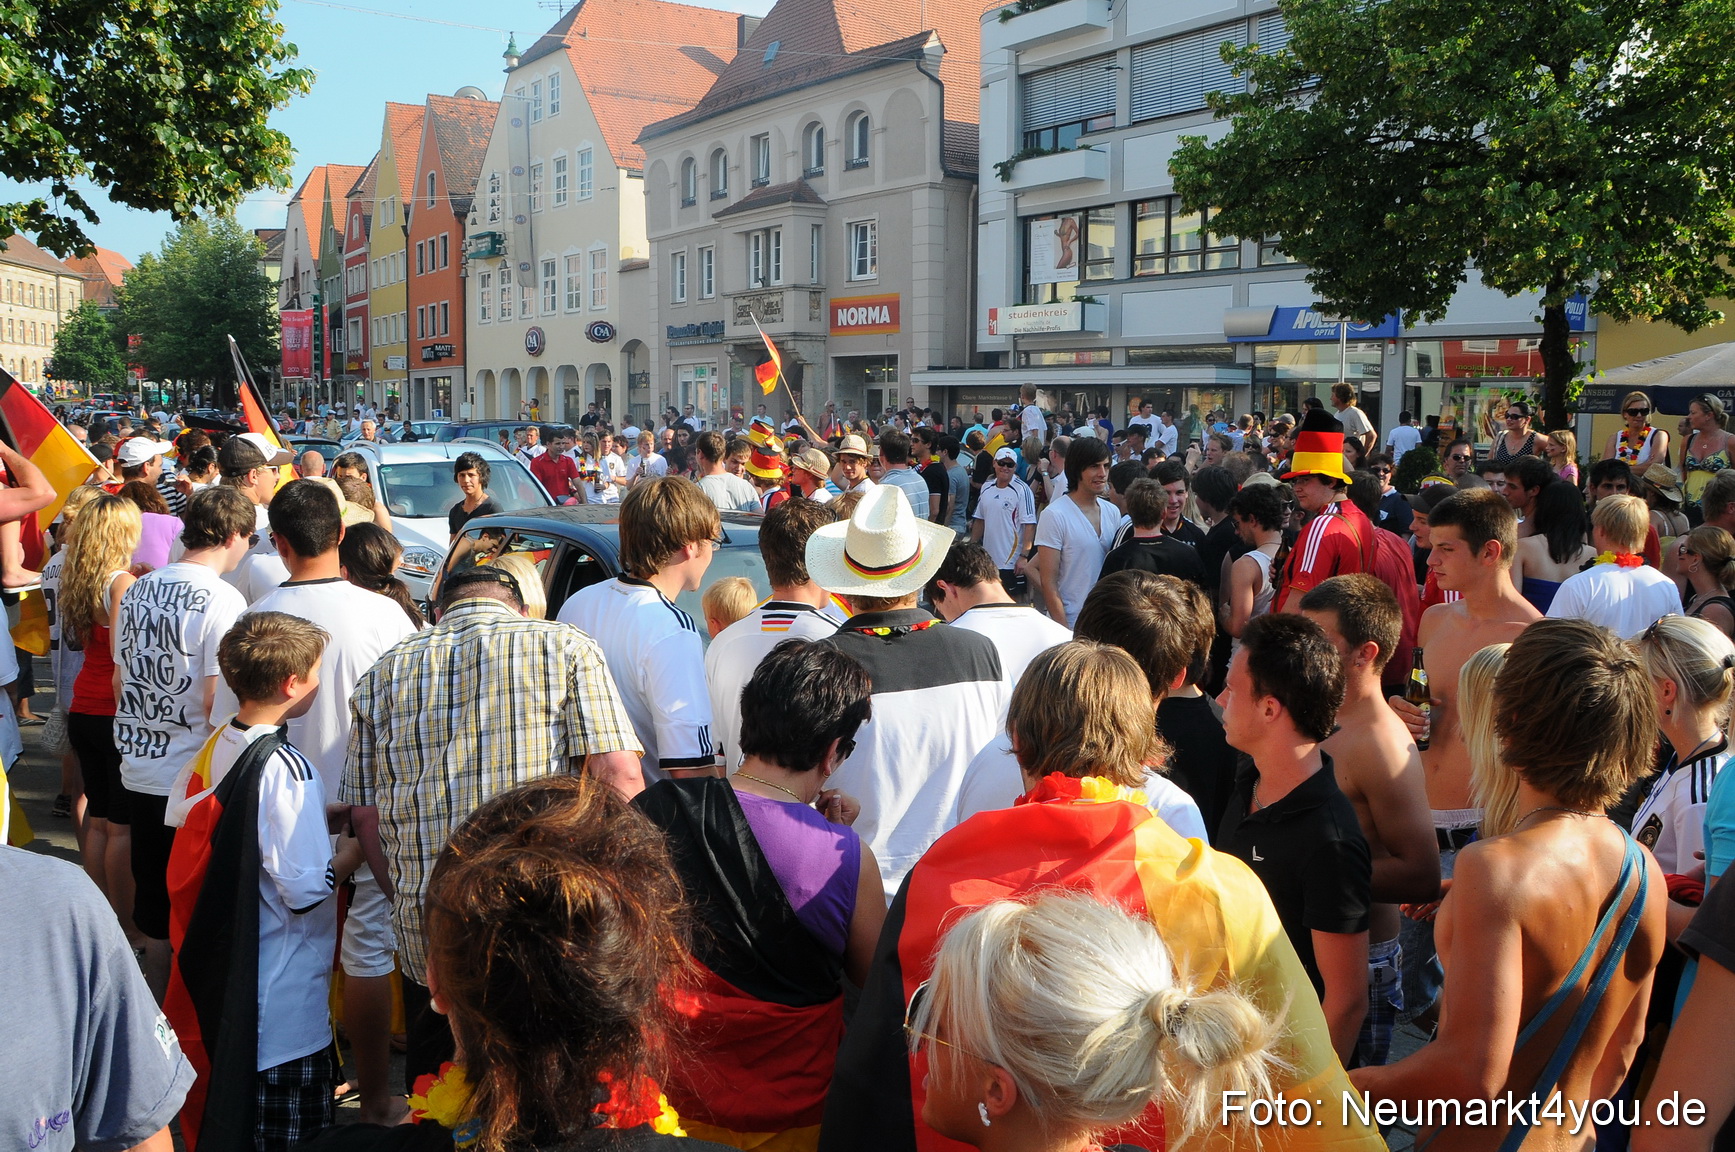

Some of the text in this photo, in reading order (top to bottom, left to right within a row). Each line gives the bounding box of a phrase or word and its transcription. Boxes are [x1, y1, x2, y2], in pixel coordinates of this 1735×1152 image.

[1008, 308, 1068, 319] studienkreis
[1564, 301, 1585, 315] POLLO
[837, 305, 891, 326] NORMA
[593, 327, 610, 337] C&A
[1314, 328, 1336, 336] OPTIK
